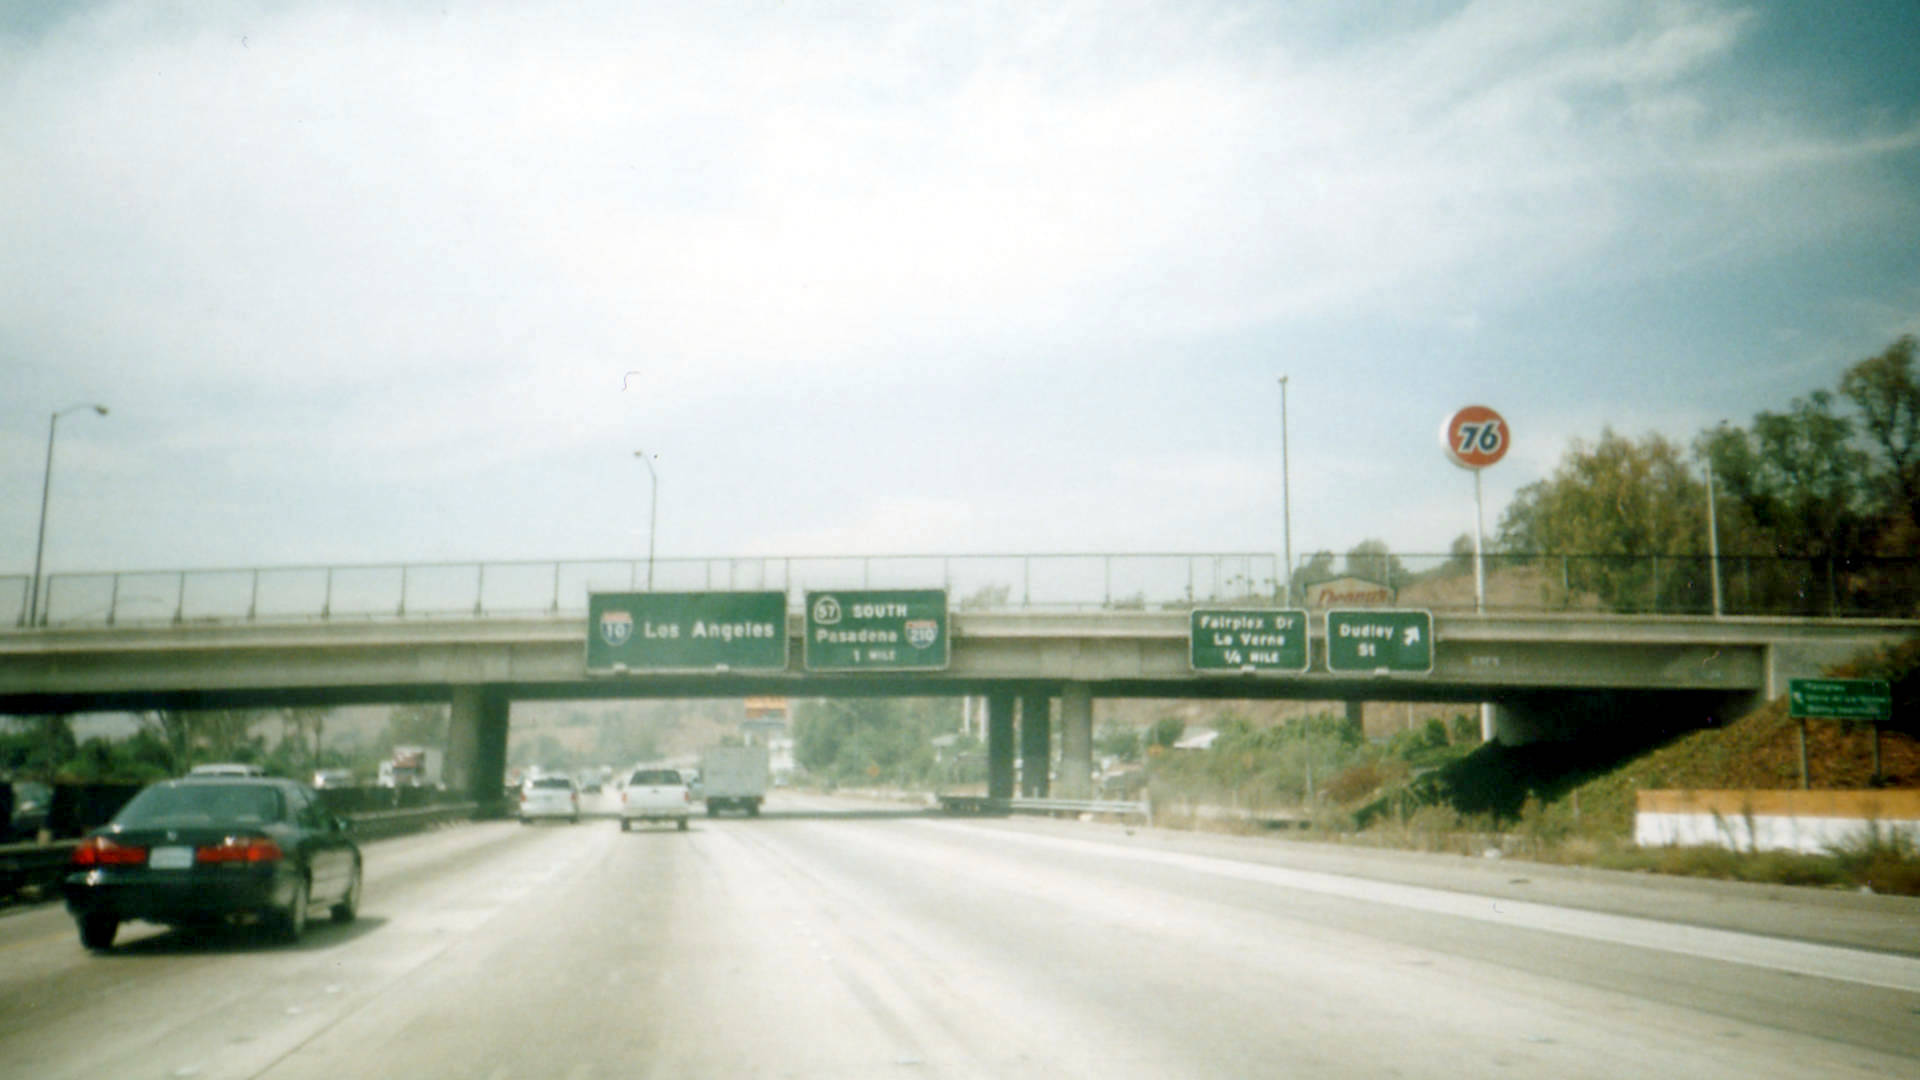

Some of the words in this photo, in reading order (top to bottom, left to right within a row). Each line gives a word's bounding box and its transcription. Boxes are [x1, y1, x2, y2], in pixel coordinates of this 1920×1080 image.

[1458, 420, 1501, 453] 76
[817, 604, 837, 619] 57
[852, 603, 908, 619] SOUTH
[606, 623, 626, 639] 10
[644, 620, 681, 639] Los
[691, 619, 775, 643] Angeles
[1200, 615, 1264, 631] Fairplex
[1275, 615, 1294, 629] Dr
[1339, 622, 1394, 640] Dudley
[816, 628, 898, 644] Pasadena
[910, 628, 936, 643] 210
[1213, 631, 1233, 646] La
[1240, 632, 1285, 646] Verne
[853, 648, 861, 664] 1
[868, 649, 897, 661] MILE
[1249, 650, 1280, 663] MILE
[1357, 642, 1376, 657] St
